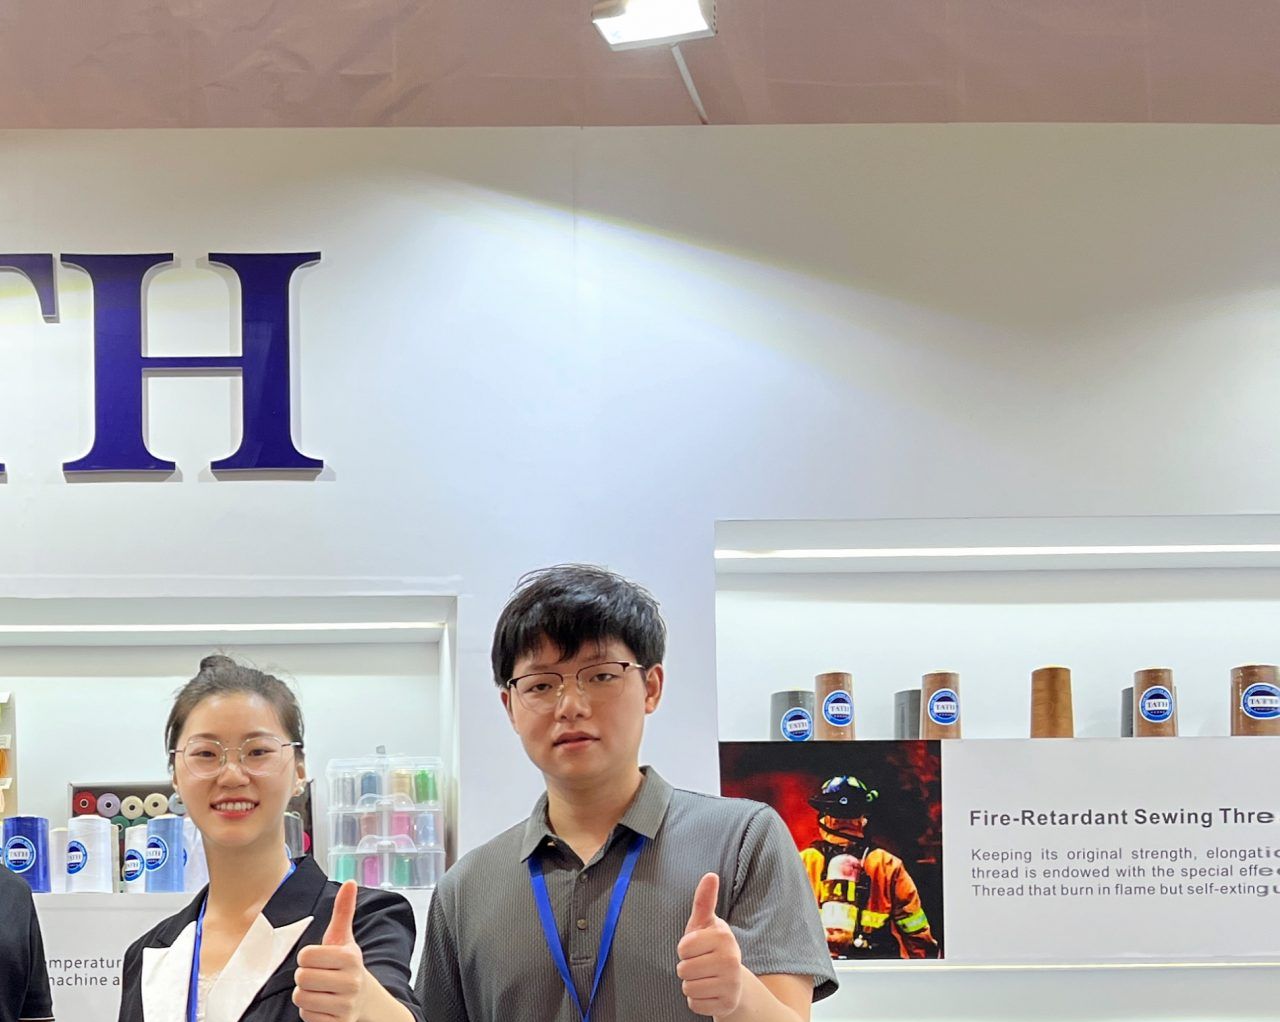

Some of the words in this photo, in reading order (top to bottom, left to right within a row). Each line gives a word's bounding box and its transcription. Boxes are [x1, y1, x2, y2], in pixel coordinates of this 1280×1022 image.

[969, 808, 1128, 826] Fire-Retardant
[1133, 807, 1213, 829] Sewing
[971, 848, 1032, 864] Keeping
[1040, 847, 1058, 860] its
[1066, 847, 1122, 863] original
[1130, 846, 1197, 862] strength,
[971, 866, 1019, 879] thread
[1024, 866, 1037, 879] is
[1041, 865, 1110, 879] endowed
[1115, 864, 1146, 878] with
[1151, 864, 1175, 877] the
[1179, 863, 1233, 880] special
[971, 883, 1024, 897] Thread
[1027, 883, 1057, 896] that
[1059, 883, 1094, 896] burn
[1097, 883, 1111, 895] in
[1113, 882, 1156, 895] flame
[1159, 882, 1183, 895] but
